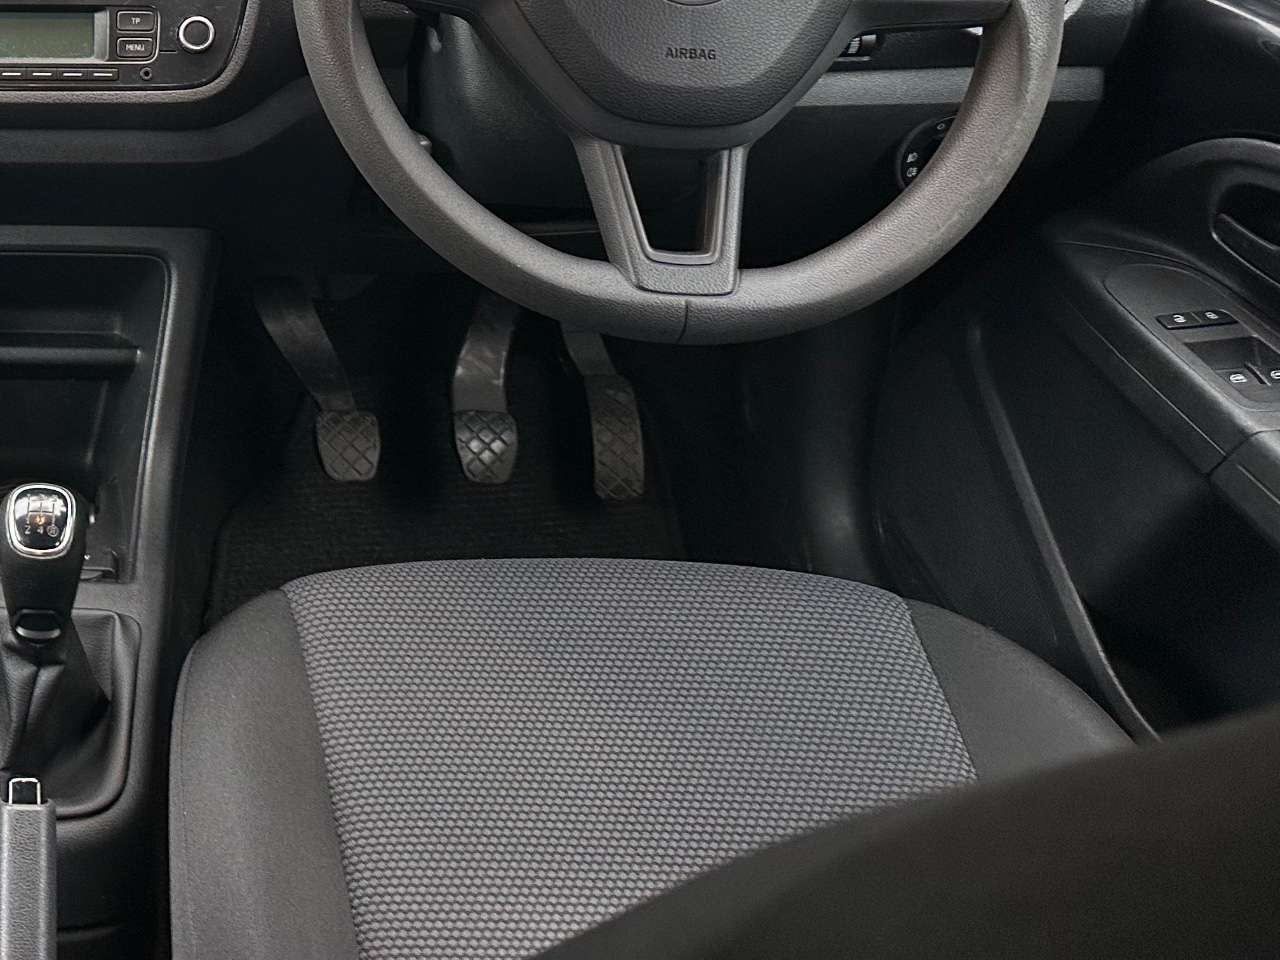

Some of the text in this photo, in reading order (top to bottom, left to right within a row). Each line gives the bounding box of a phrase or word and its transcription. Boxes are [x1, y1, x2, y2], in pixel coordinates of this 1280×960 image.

[131, 17, 141, 25] TP
[125, 43, 145, 52] MENU
[664, 47, 717, 60] AIRBAG
